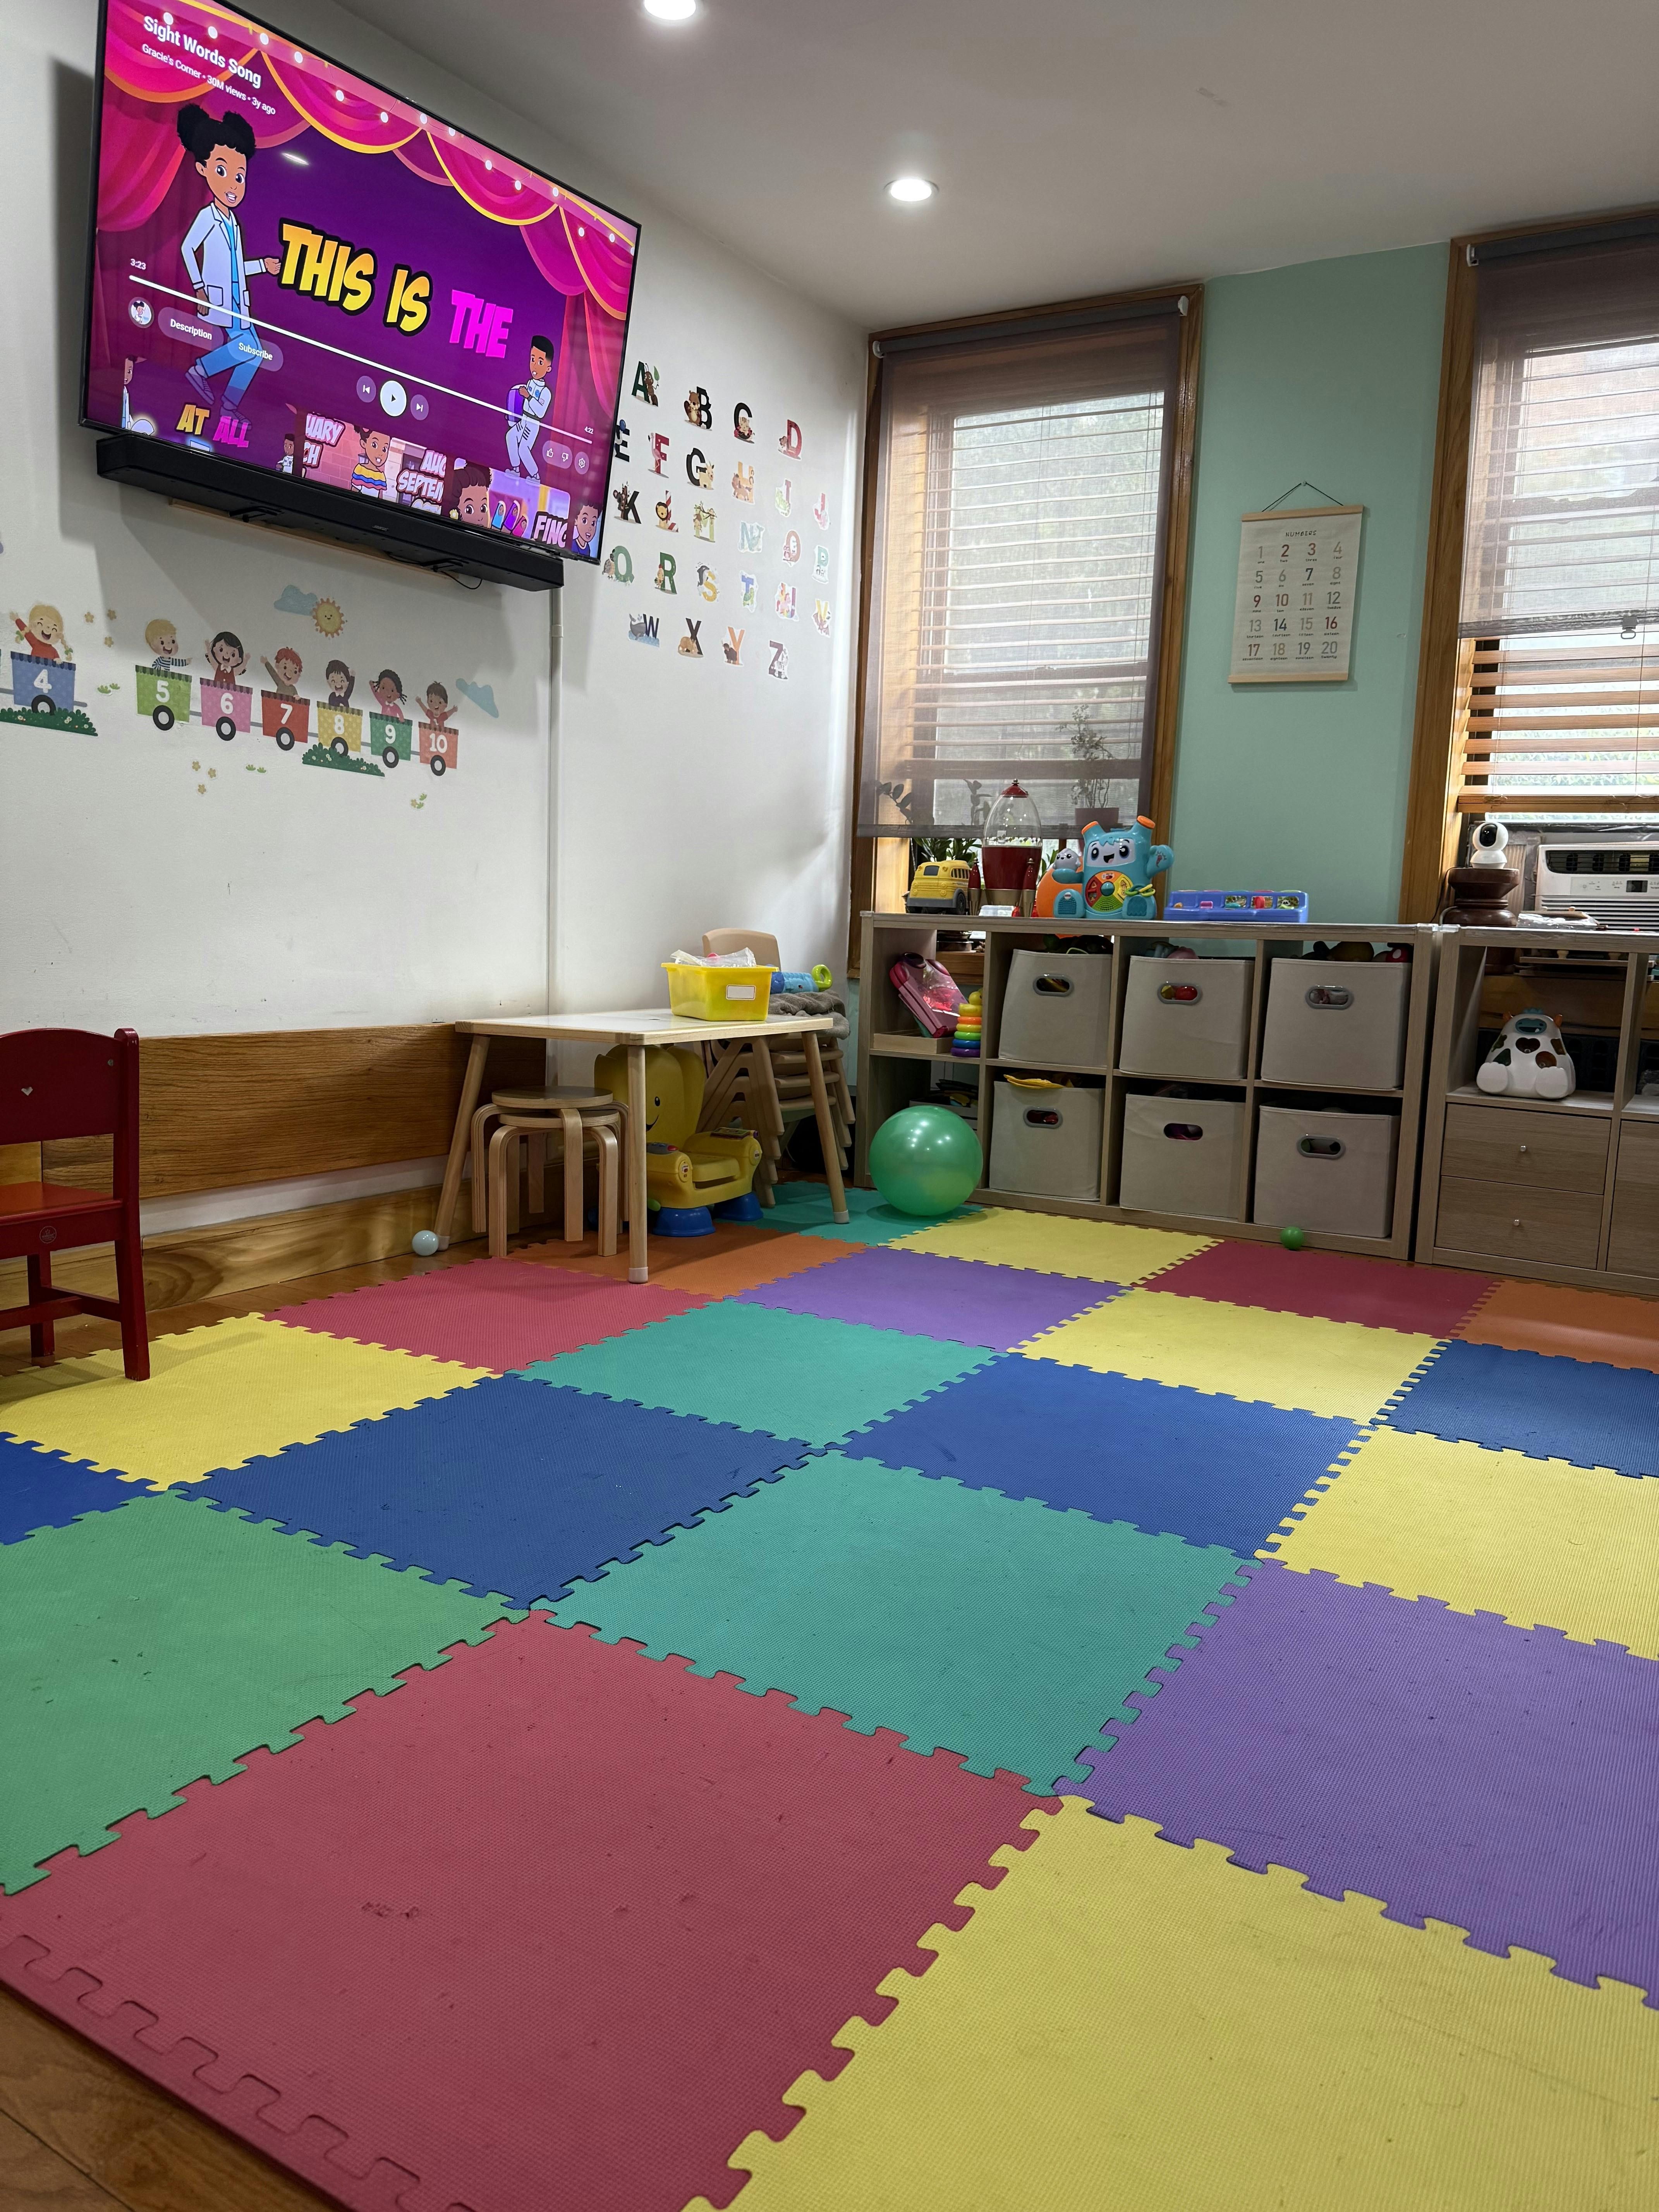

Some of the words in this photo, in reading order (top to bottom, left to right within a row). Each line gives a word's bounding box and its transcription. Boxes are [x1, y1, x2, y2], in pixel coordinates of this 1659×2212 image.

[144, 16, 180, 46] Sight
[184, 34, 225, 68] Words
[228, 58, 261, 89] Song
[142, 44, 174, 66] Gracie's
[175, 60, 201, 79] Corner
[207, 75, 224, 90] 30M
[225, 85, 246, 101] views
[252, 97, 261, 109] 3y
[262, 103, 276, 115] ago
[130, 258, 146, 270] 3:23
[282, 223, 374, 311] THIS
[386, 269, 430, 331] IS
[449, 289, 513, 359] THE
[170, 318, 212, 340] Description
[238, 342, 273, 360] Subscribe
[176, 404, 210, 434] AT
[213, 416, 249, 448] ALL
[632, 361, 651, 404] A
[697, 386, 712, 429] B
[734, 402, 752, 440] C
[787, 419, 802, 458] D
[615, 424, 630, 462] E
[654, 433, 670, 474] F
[686, 447, 708, 488] G
[737, 461, 754, 504] H
[622, 489, 642, 524] K
[665, 490, 679, 533] L
[740, 521, 755, 553] N
[786, 530, 800, 562] O
[1259, 546, 1263, 558] 1
[1281, 544, 1289, 557] 2
[1307, 543, 1316, 555] 3
[1333, 541, 1342, 554] 4
[659, 552, 677, 594] R
[698, 565, 717, 602] S
[1255, 570, 1263, 583] 5
[1279, 569, 1286, 582] 6
[1305, 568, 1314, 580] 7
[1333, 567, 1341, 579] 8
[1254, 595, 1261, 608] 9
[1276, 594, 1289, 606] 10
[1303, 592, 1313, 605] 11
[1327, 591, 1341, 604] 12
[643, 613, 659, 639] W
[685, 617, 703, 655] X
[728, 626, 745, 665] Y
[768, 640, 786, 679] Z
[1249, 619, 1261, 632] 13
[1274, 618, 1287, 631] 14
[1300, 617, 1313, 630] 15
[1325, 616, 1338, 629] 16
[1248, 644, 1260, 656] 17
[1273, 643, 1285, 655] 18
[1298, 642, 1310, 655] 19
[1321, 641, 1338, 654] 20
[34, 669, 52, 693] 4
[156, 680, 170, 703] 5
[220, 693, 234, 714] 6
[280, 703, 293, 724] 7
[334, 714, 345, 735] 8
[386, 725, 396, 744] 9
[429, 733, 448, 753] 10
